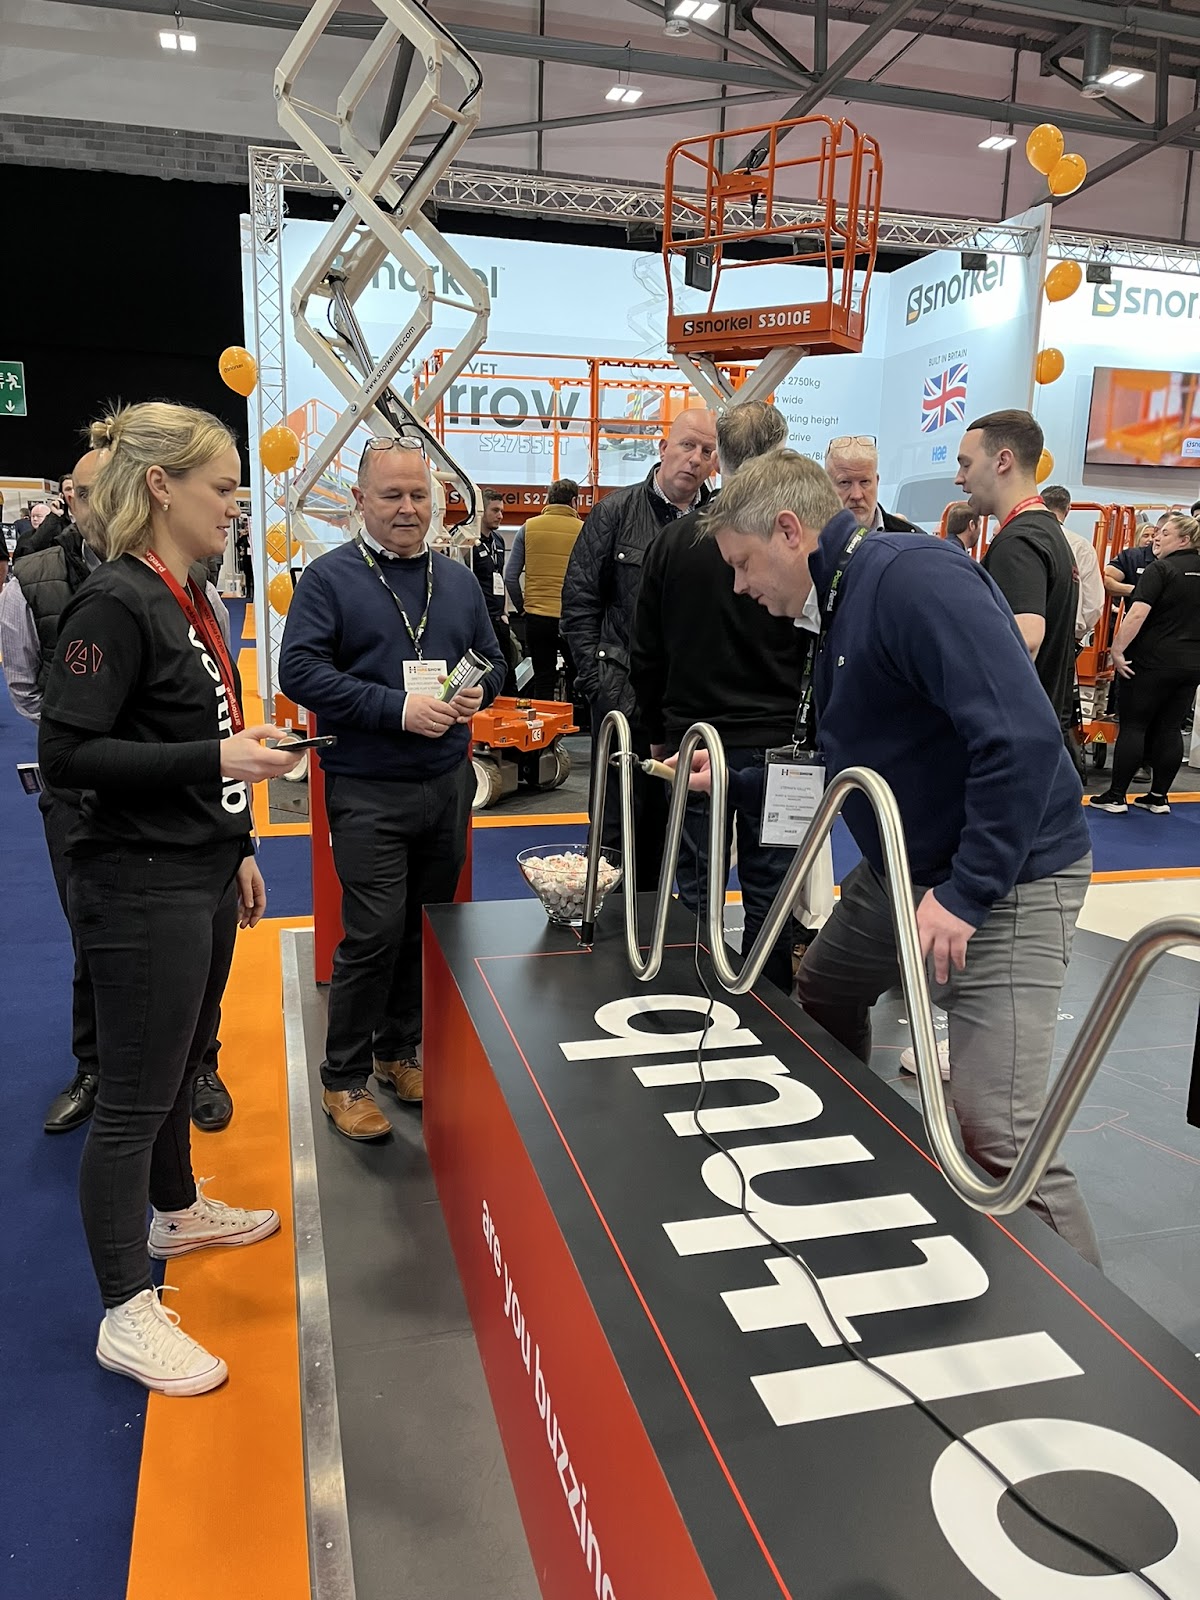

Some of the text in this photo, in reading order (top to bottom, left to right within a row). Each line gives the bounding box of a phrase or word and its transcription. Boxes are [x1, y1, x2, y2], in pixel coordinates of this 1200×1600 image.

[696, 309, 811, 333] snorkel S3010E
[788, 376, 821, 389] 2750kg
[782, 394, 804, 405] wide
[810, 415, 839, 426] height
[788, 432, 812, 442] drive
[483, 1200, 502, 1278] are
[504, 1261, 531, 1375] you
